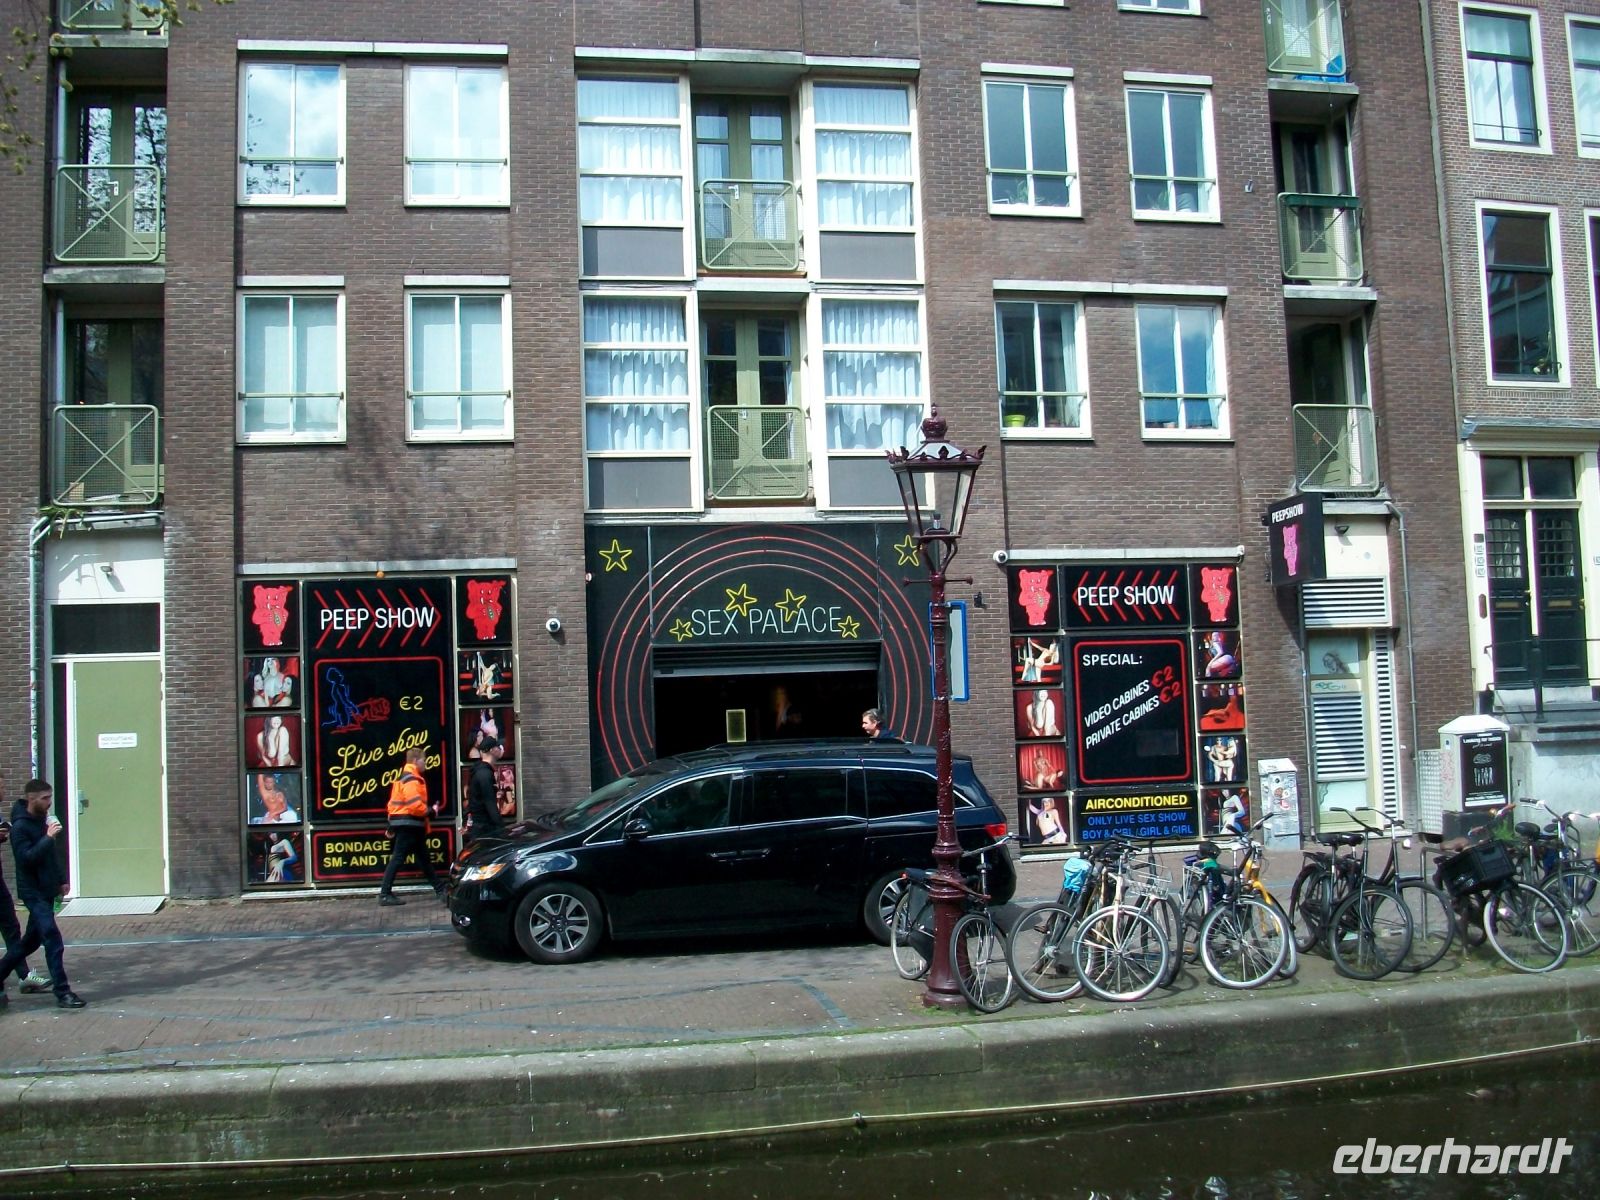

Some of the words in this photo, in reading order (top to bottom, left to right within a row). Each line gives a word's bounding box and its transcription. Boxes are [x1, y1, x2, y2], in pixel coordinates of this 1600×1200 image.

[1271, 503, 1304, 523] PEEPSHOW
[1078, 586, 1119, 606] PEEP
[1123, 585, 1174, 605] SHOW
[321, 608, 369, 630] PEEP
[375, 607, 434, 629] SHOW
[691, 609, 739, 636] SEX
[748, 606, 842, 634] PALACE
[1082, 653, 1143, 666] SPECIAL:
[400, 696, 423, 710] €2
[1084, 703, 1112, 728] VIDEO
[1112, 679, 1150, 710] CABINES
[1085, 718, 1121, 750] PRIVATE
[1122, 695, 1160, 726] CABINES
[329, 744, 384, 776] Live
[387, 727, 428, 756] show
[322, 775, 378, 808] Live
[381, 745, 441, 787] coes
[1085, 794, 1188, 810] AIRCONDITIONED
[1087, 816, 1112, 826] ONLY
[1115, 814, 1136, 824] LIVE
[1138, 813, 1156, 823] SEX
[1158, 812, 1187, 822] SHOW
[1082, 830, 1102, 840] BOY
[1139, 826, 1161, 837] GIRL
[325, 840, 391, 854] BONDAGE
[350, 855, 378, 867] AND
